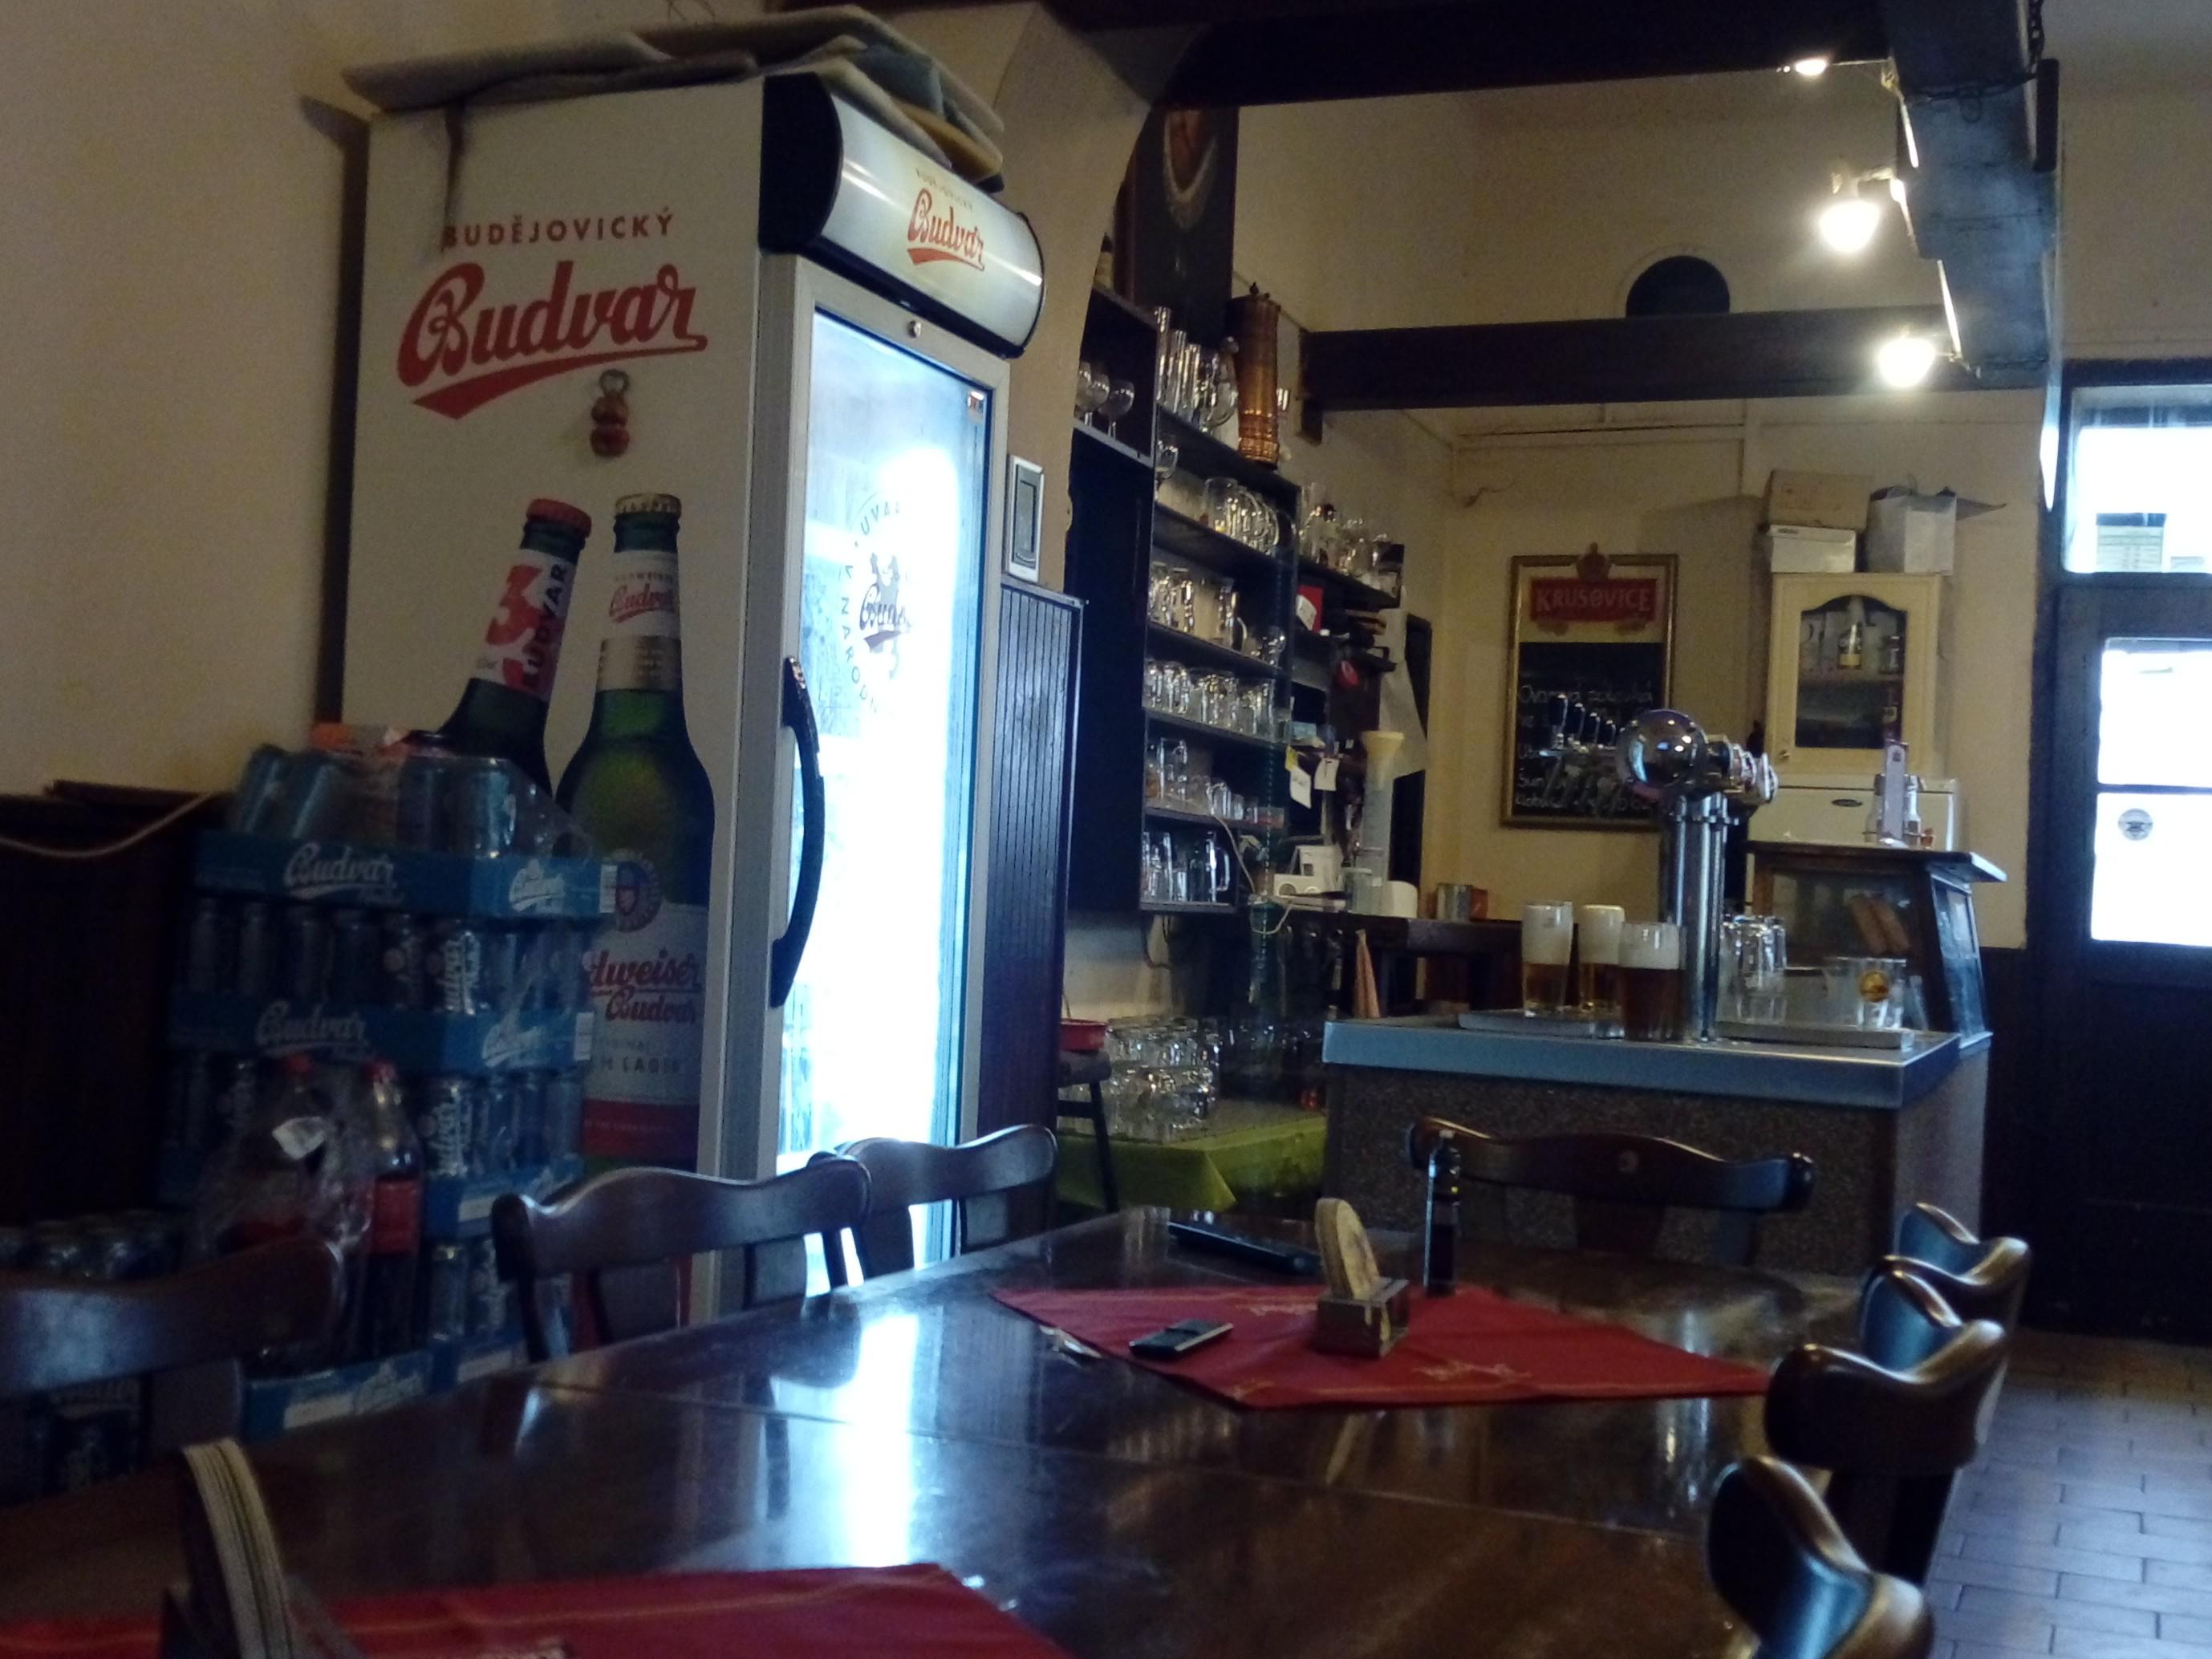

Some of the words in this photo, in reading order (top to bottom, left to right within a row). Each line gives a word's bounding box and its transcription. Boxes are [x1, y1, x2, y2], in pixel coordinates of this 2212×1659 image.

[443, 207, 675, 248] BUDĚJOVICKÝ
[907, 188, 984, 270] Budvar
[397, 259, 708, 417] Budvar
[284, 842, 396, 897] Budvar
